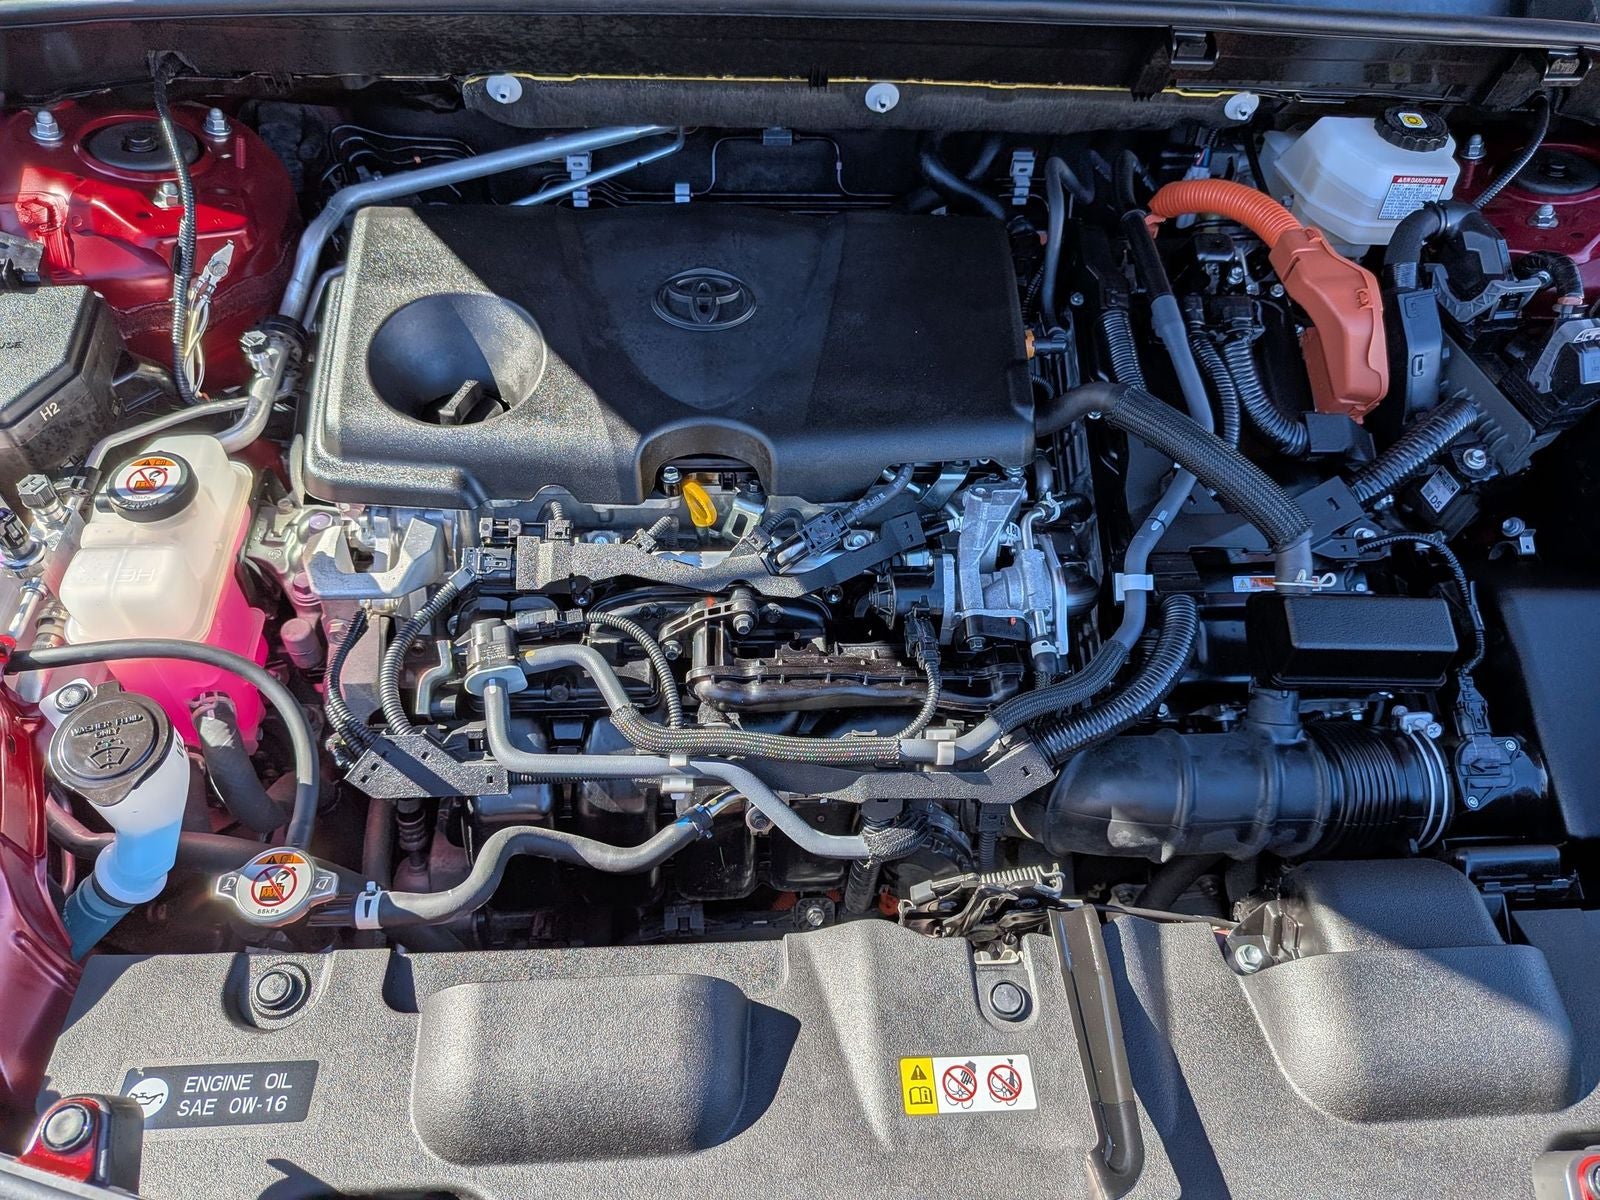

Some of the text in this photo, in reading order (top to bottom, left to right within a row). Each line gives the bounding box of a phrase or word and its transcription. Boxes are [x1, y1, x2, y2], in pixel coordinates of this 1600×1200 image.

[40, 402, 60, 421] H2
[70, 714, 144, 737] WASHER FLUID
[94, 727, 120, 739] ONLY
[184, 1073, 293, 1093] ENGINE OIL
[176, 1095, 288, 1117] SAE 0W-16
